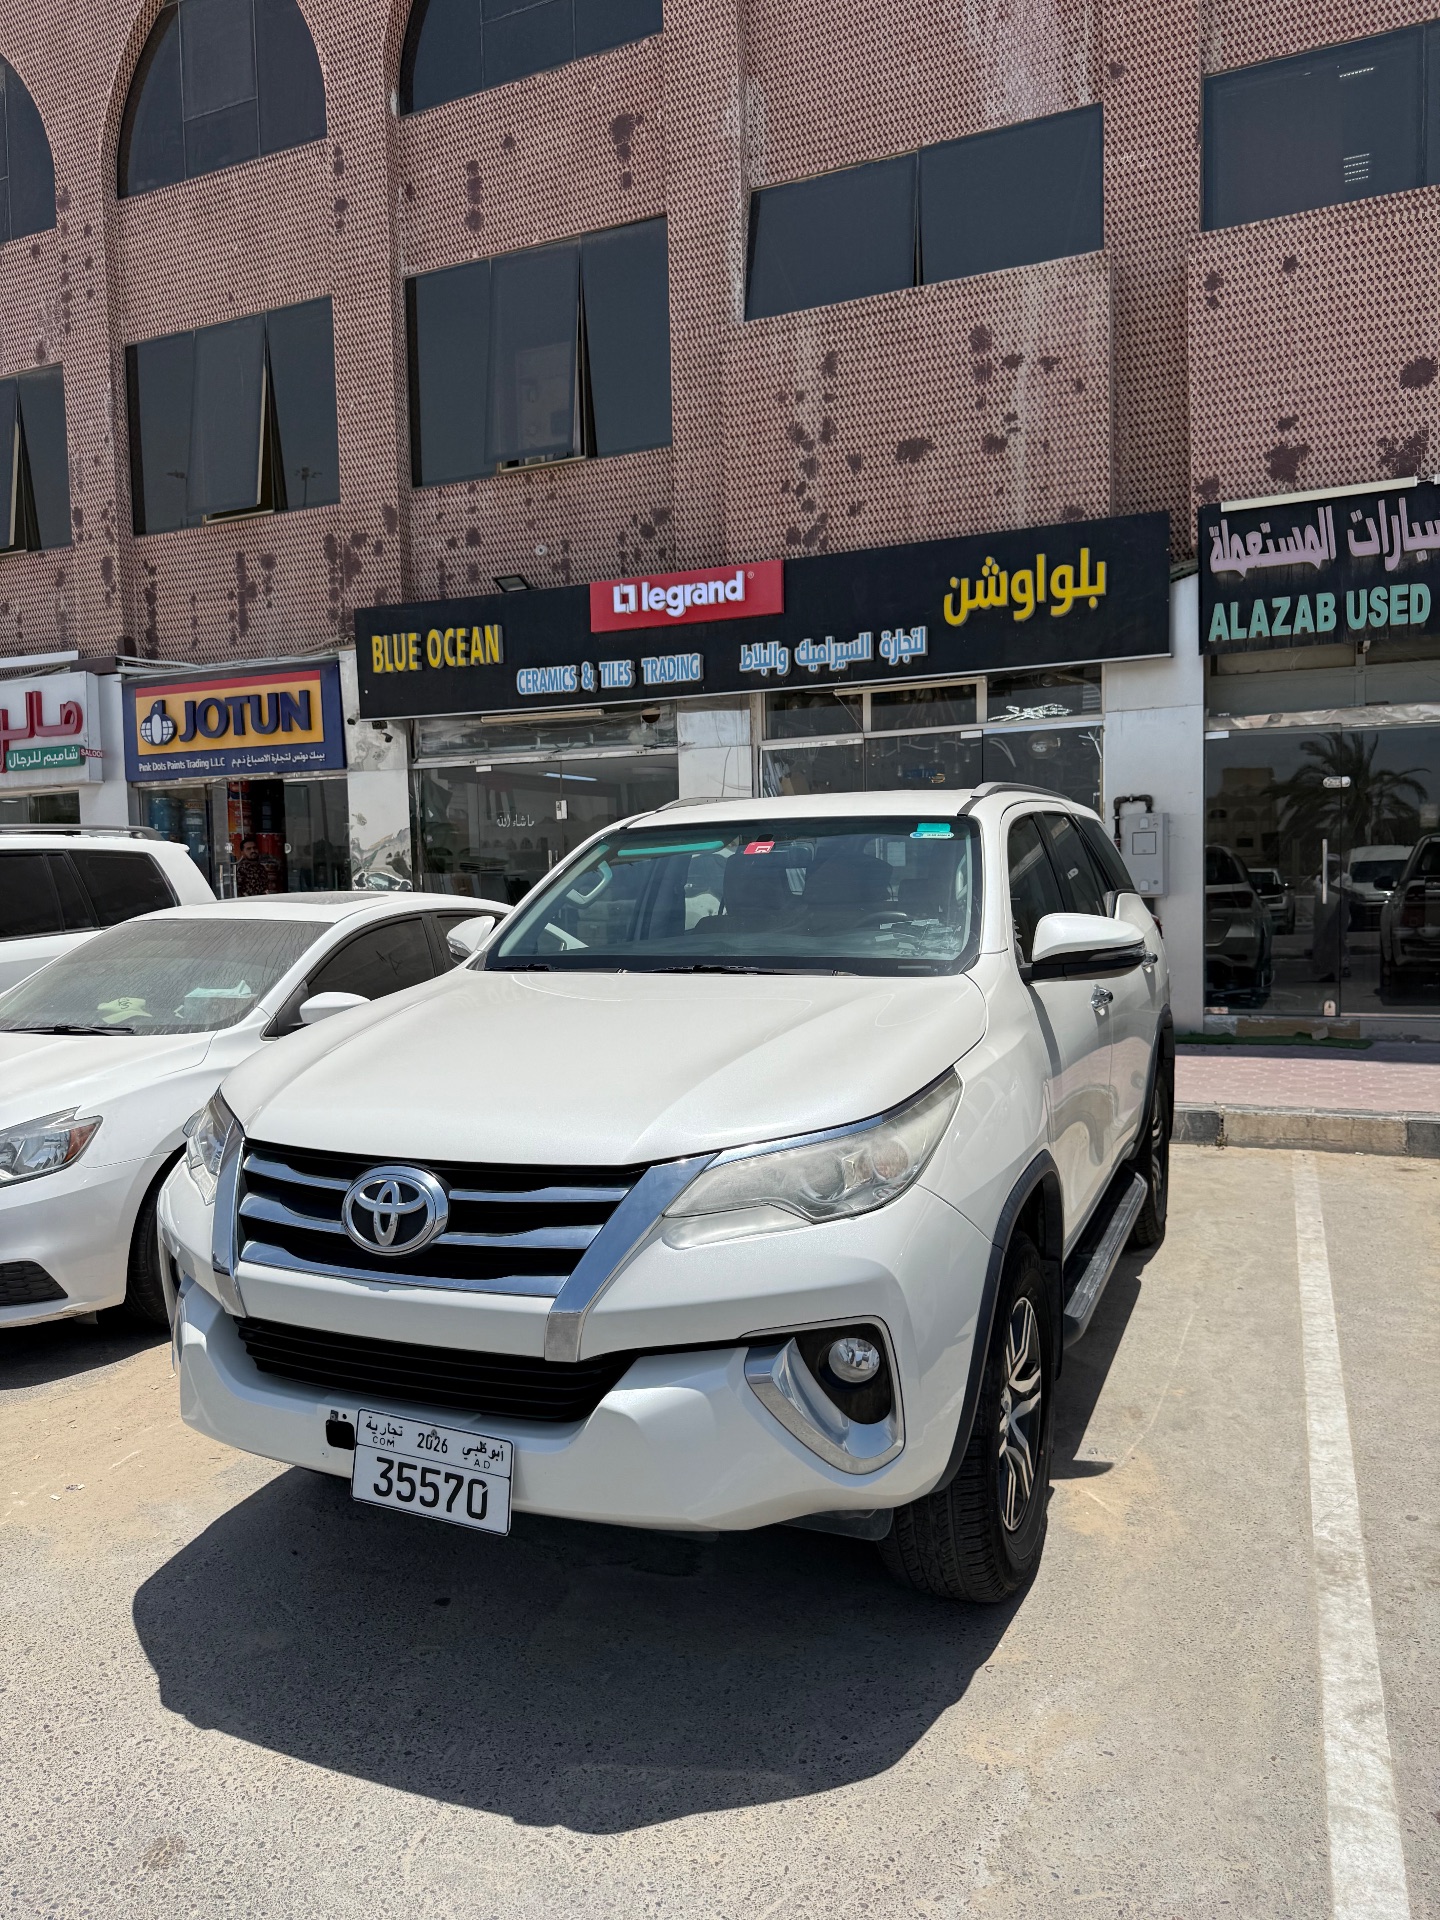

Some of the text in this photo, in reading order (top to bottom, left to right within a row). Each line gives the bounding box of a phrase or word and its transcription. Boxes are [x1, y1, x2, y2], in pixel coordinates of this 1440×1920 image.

[1209, 505, 1336, 578] المستعملة
[641, 570, 745, 617] legrand
[944, 547, 1106, 627] بلواوشن
[1208, 583, 1431, 642] ALAZAB USED
[372, 624, 503, 673] BLUE OCEAN
[739, 626, 928, 677] لتجارة السيراميك والبلاط
[516, 653, 704, 695] CERAMICS & TILES TRADING
[179, 690, 312, 742] JOTUN
[8, 750, 42, 769] للرجال
[152, 761, 166, 771] Dots
[167, 760, 185, 770] Paints
[186, 758, 209, 770] Trading
[366, 1416, 403, 1438] تجارية
[372, 1435, 396, 1448] COM
[416, 1432, 448, 1454] 2026
[373, 1456, 488, 1521] 35570
